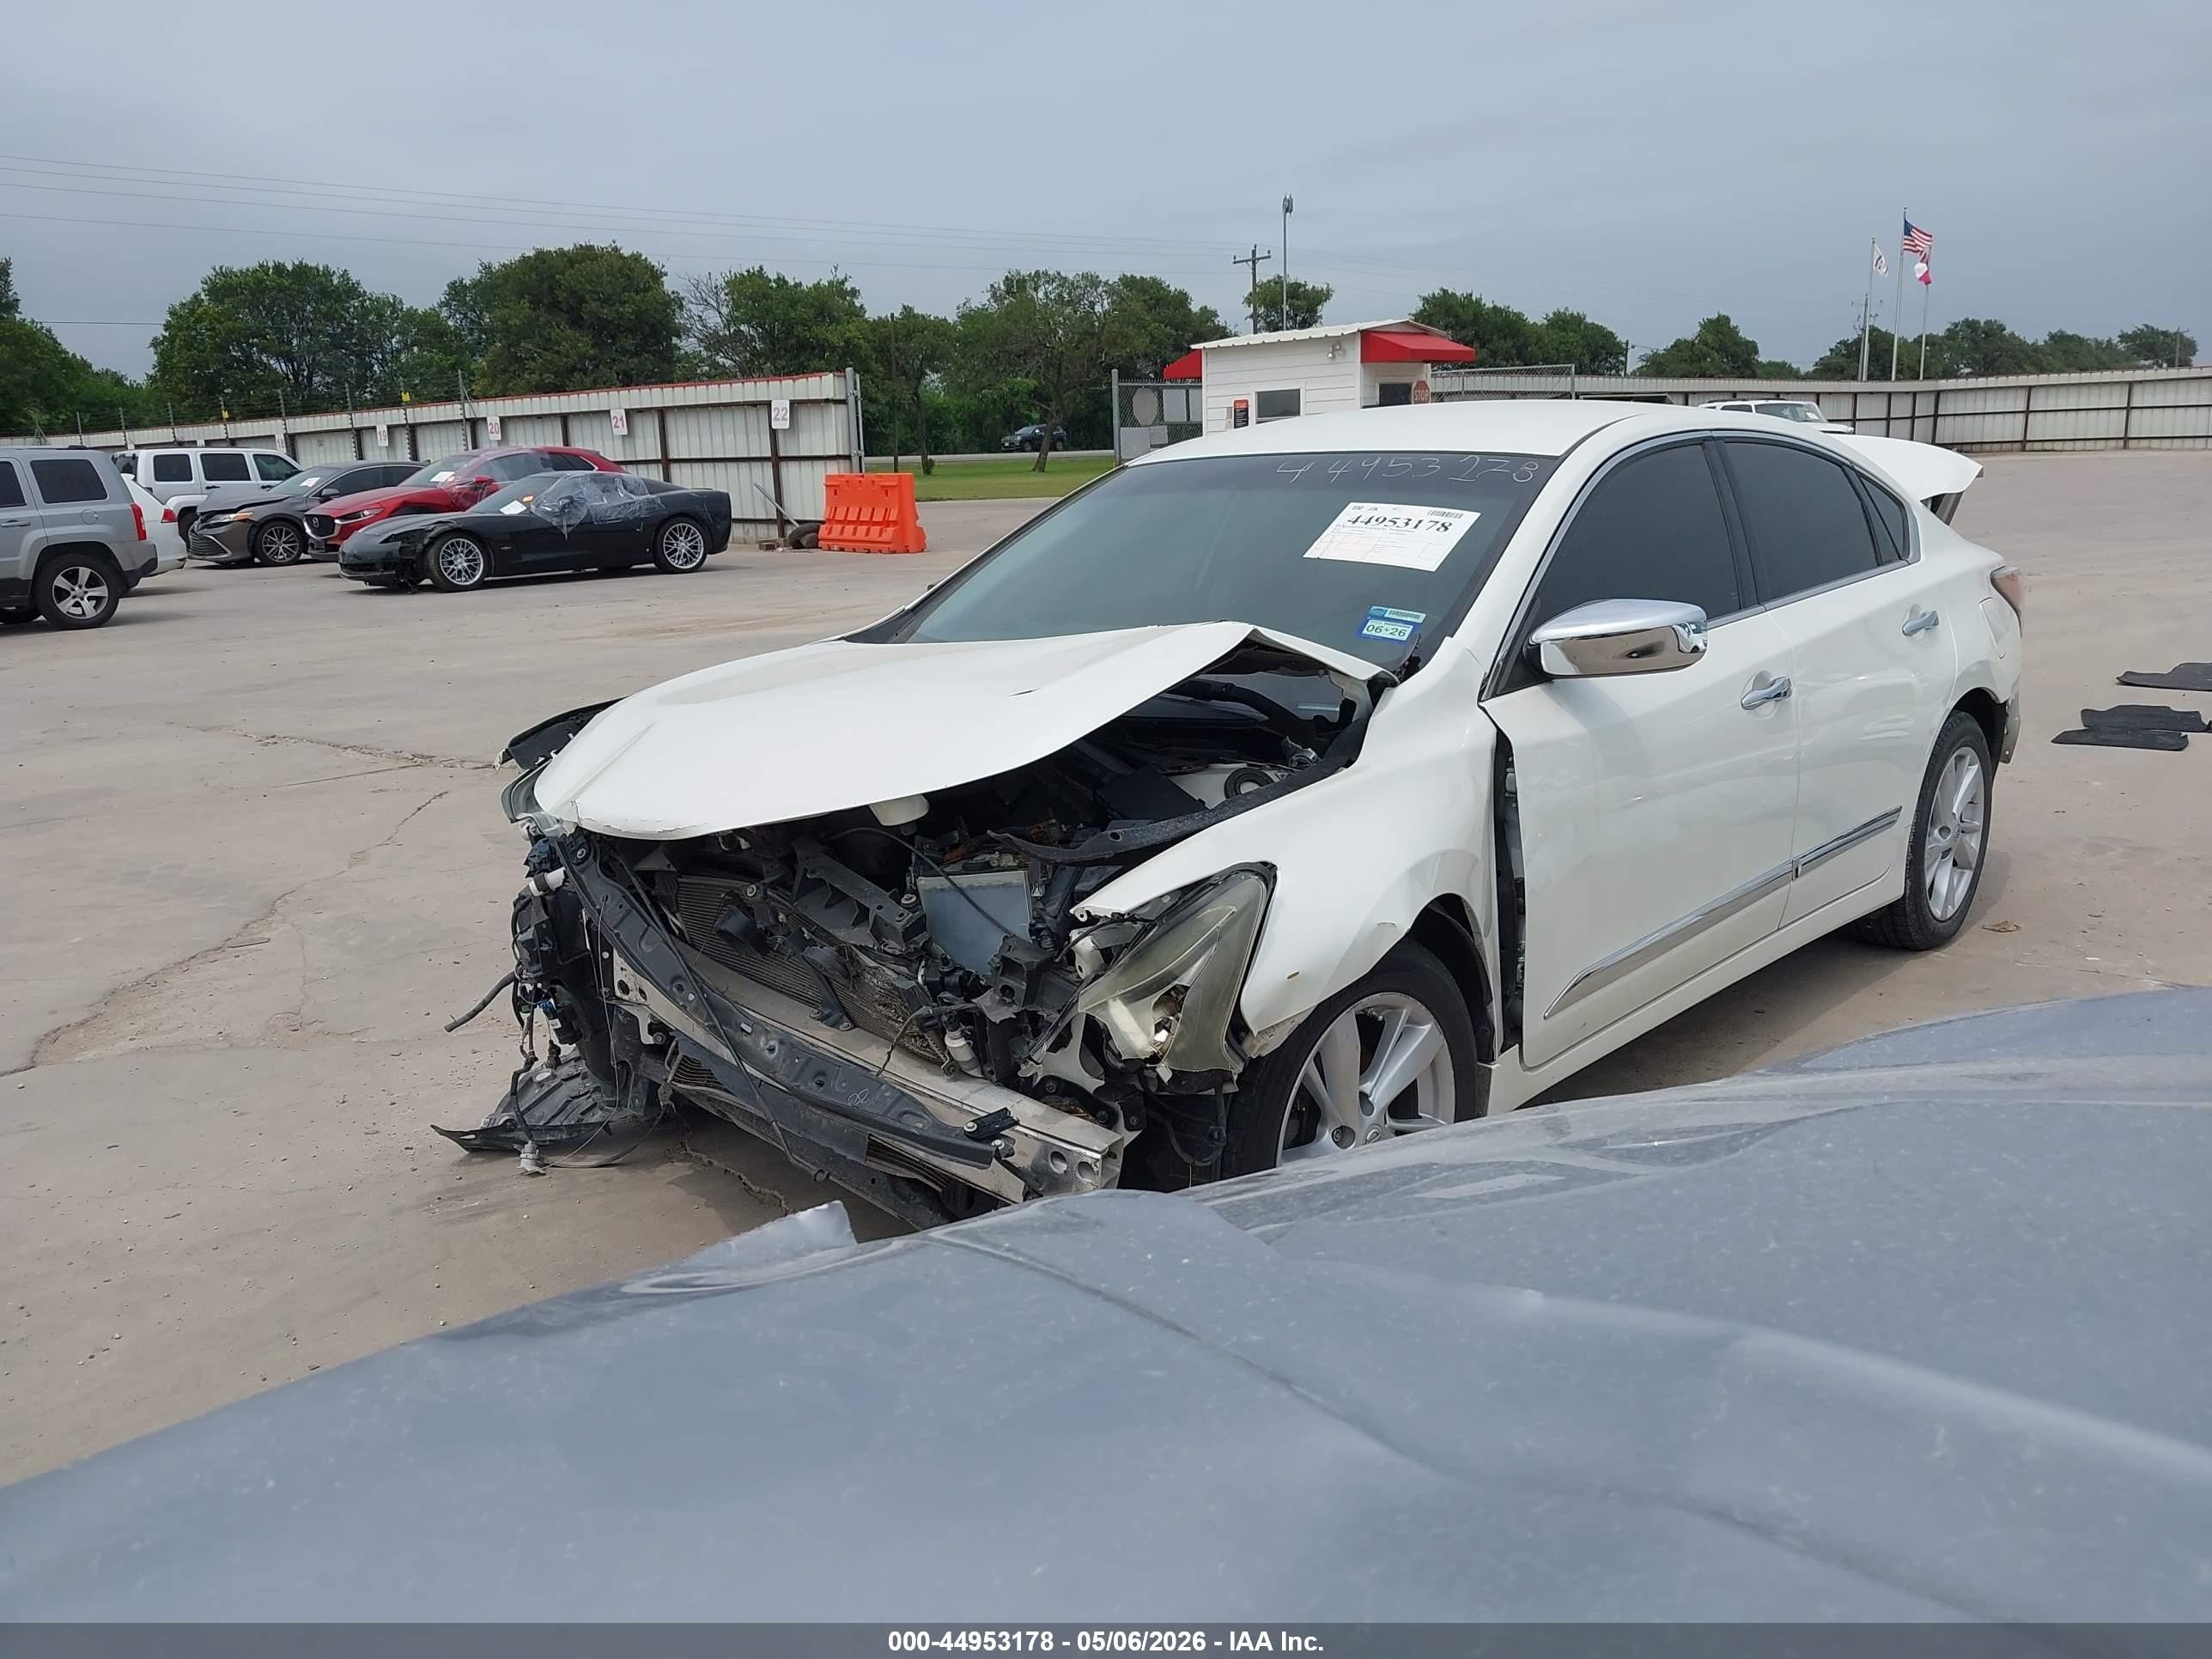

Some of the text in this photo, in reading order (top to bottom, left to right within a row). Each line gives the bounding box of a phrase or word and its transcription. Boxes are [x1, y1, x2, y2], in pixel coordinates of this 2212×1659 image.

[1414, 389, 1429, 401] STOP
[773, 407, 788, 422] 22
[489, 422, 500, 434] 20
[612, 415, 625, 428] 21
[378, 430, 387, 441] 19
[1346, 514, 1453, 533] 44953178
[1365, 624, 1408, 637] 06 26
